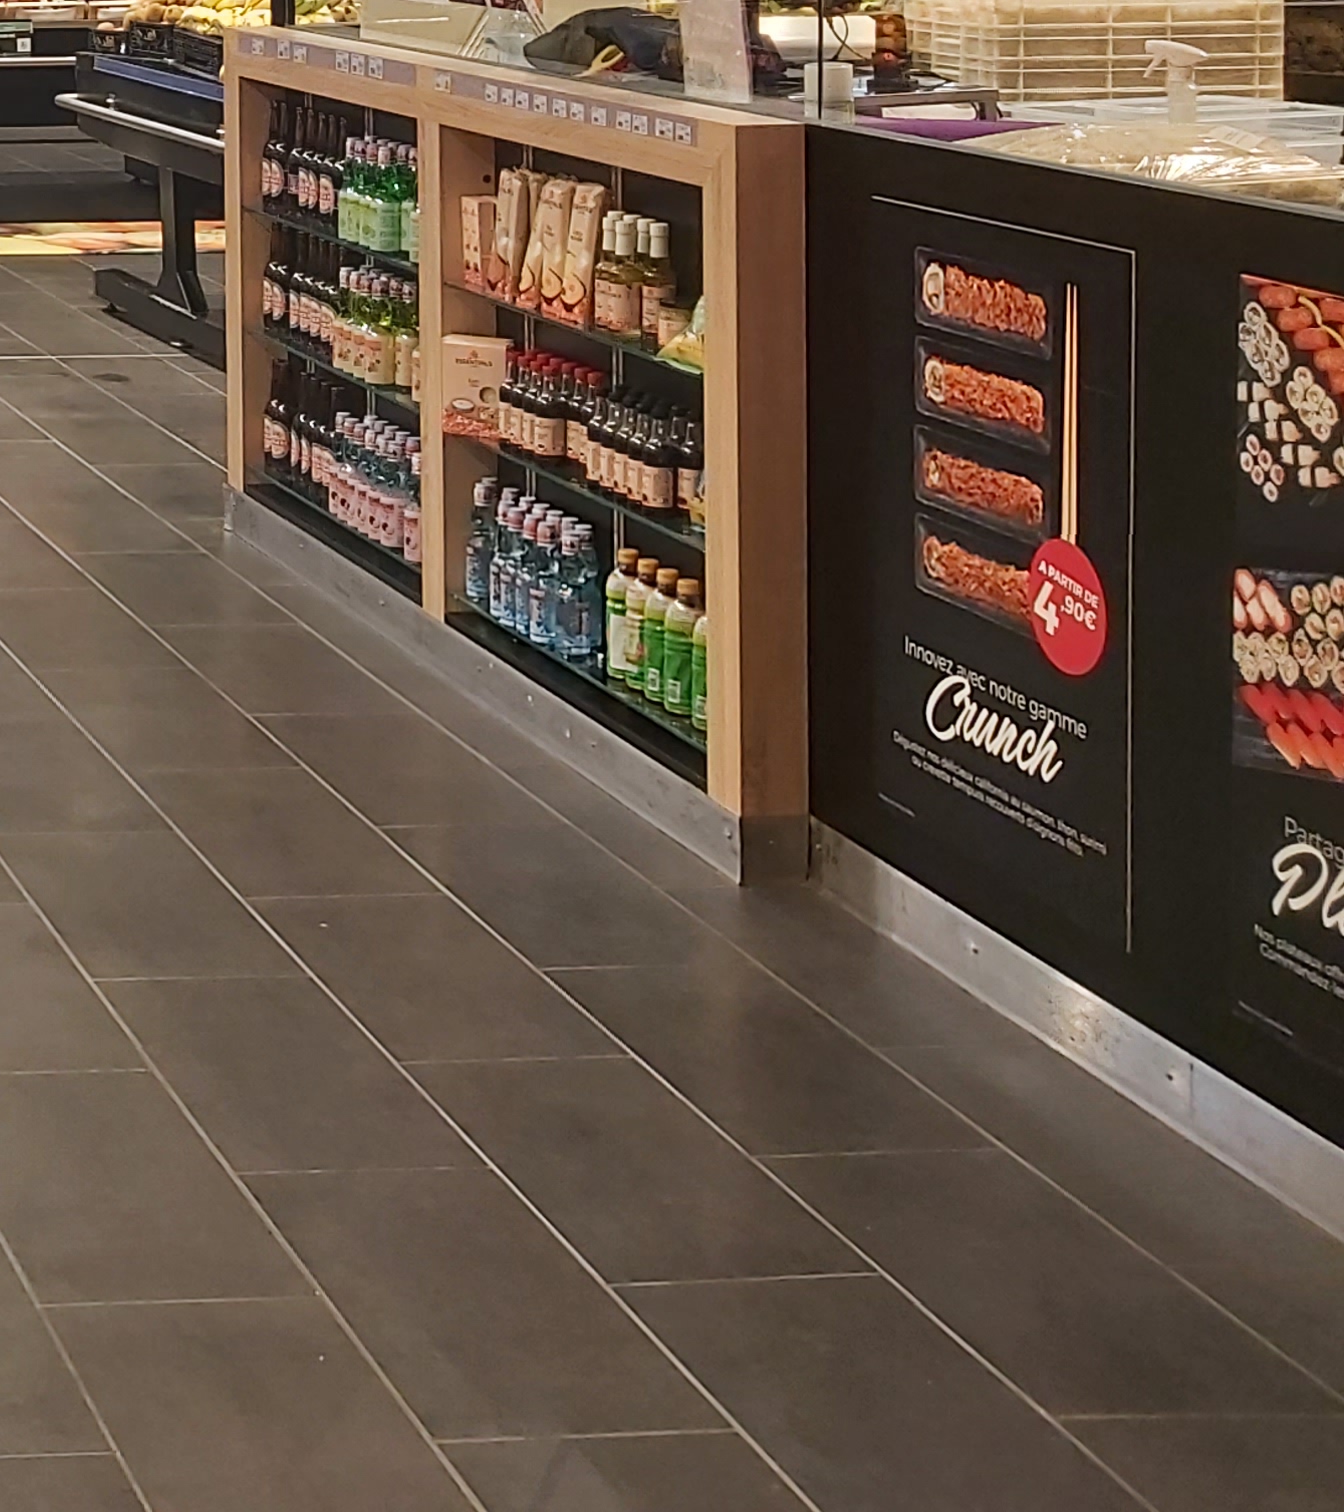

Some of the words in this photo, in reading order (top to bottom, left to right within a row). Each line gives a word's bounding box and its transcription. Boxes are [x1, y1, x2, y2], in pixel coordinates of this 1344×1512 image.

[1048, 564, 1084, 598] PARTIR
[1084, 589, 1101, 609] DE
[904, 635, 954, 675] Innovez
[956, 664, 987, 692] avec
[989, 678, 1027, 710] notre
[1028, 698, 1088, 739] gamme
[924, 674, 1064, 784] Crunch
[1272, 842, 1344, 938] Pl
